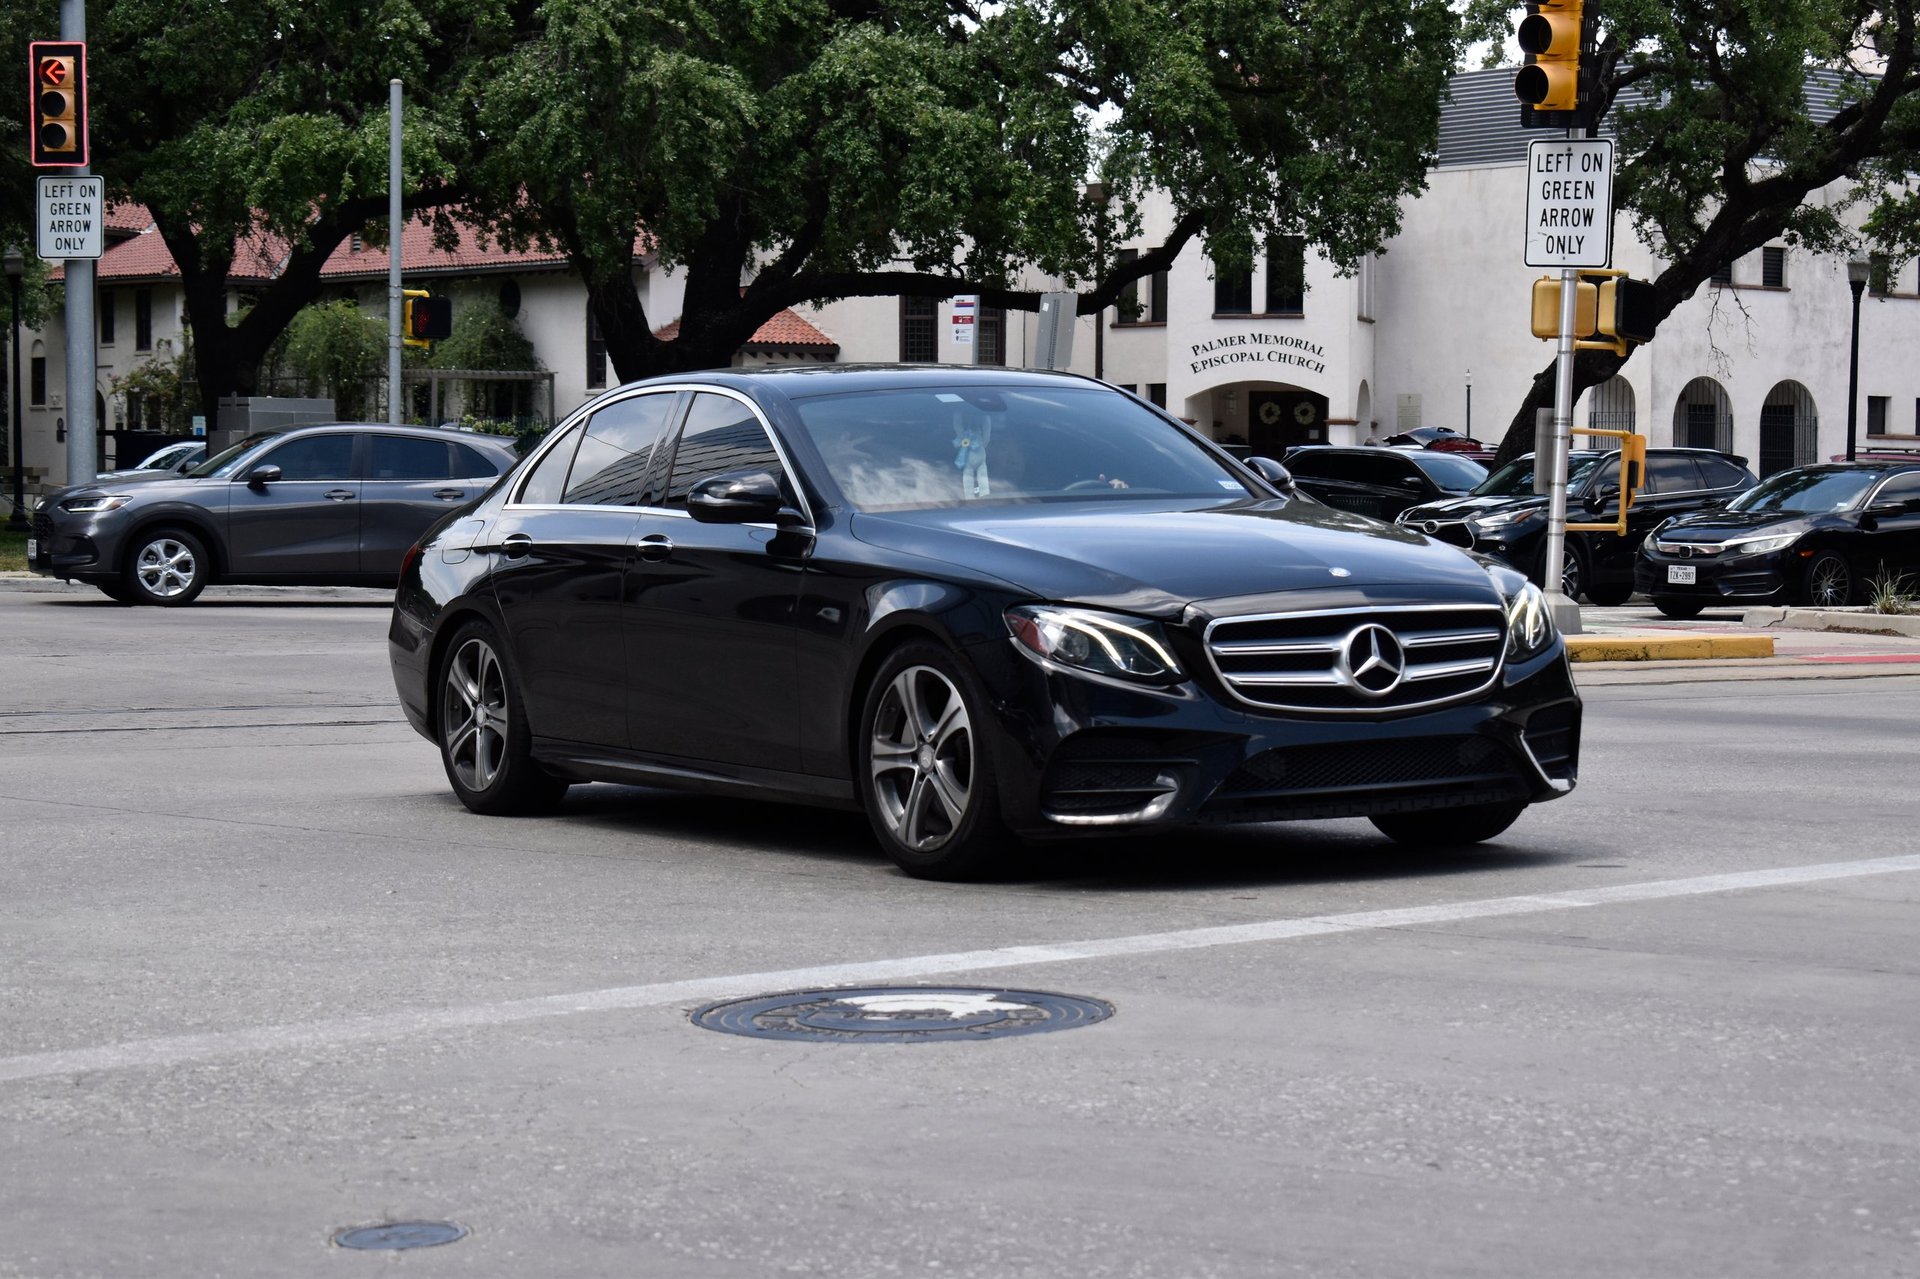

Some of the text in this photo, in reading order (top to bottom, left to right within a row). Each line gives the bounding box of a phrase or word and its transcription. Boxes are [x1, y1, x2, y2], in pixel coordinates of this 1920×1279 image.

[1537, 152, 1603, 173] LEFT ON
[45, 185, 96, 198] LEFT ON
[1542, 180, 1595, 200] GREEN
[50, 202, 91, 216] GREEN
[1539, 207, 1595, 228] ARROW
[49, 220, 92, 233] ARROW
[55, 237, 86, 251] ONLY
[1545, 235, 1585, 255] ONLY
[1191, 333, 1326, 358] PALMER MEMORIAL
[1190, 350, 1326, 375] EPISCOPAL CHURCH
